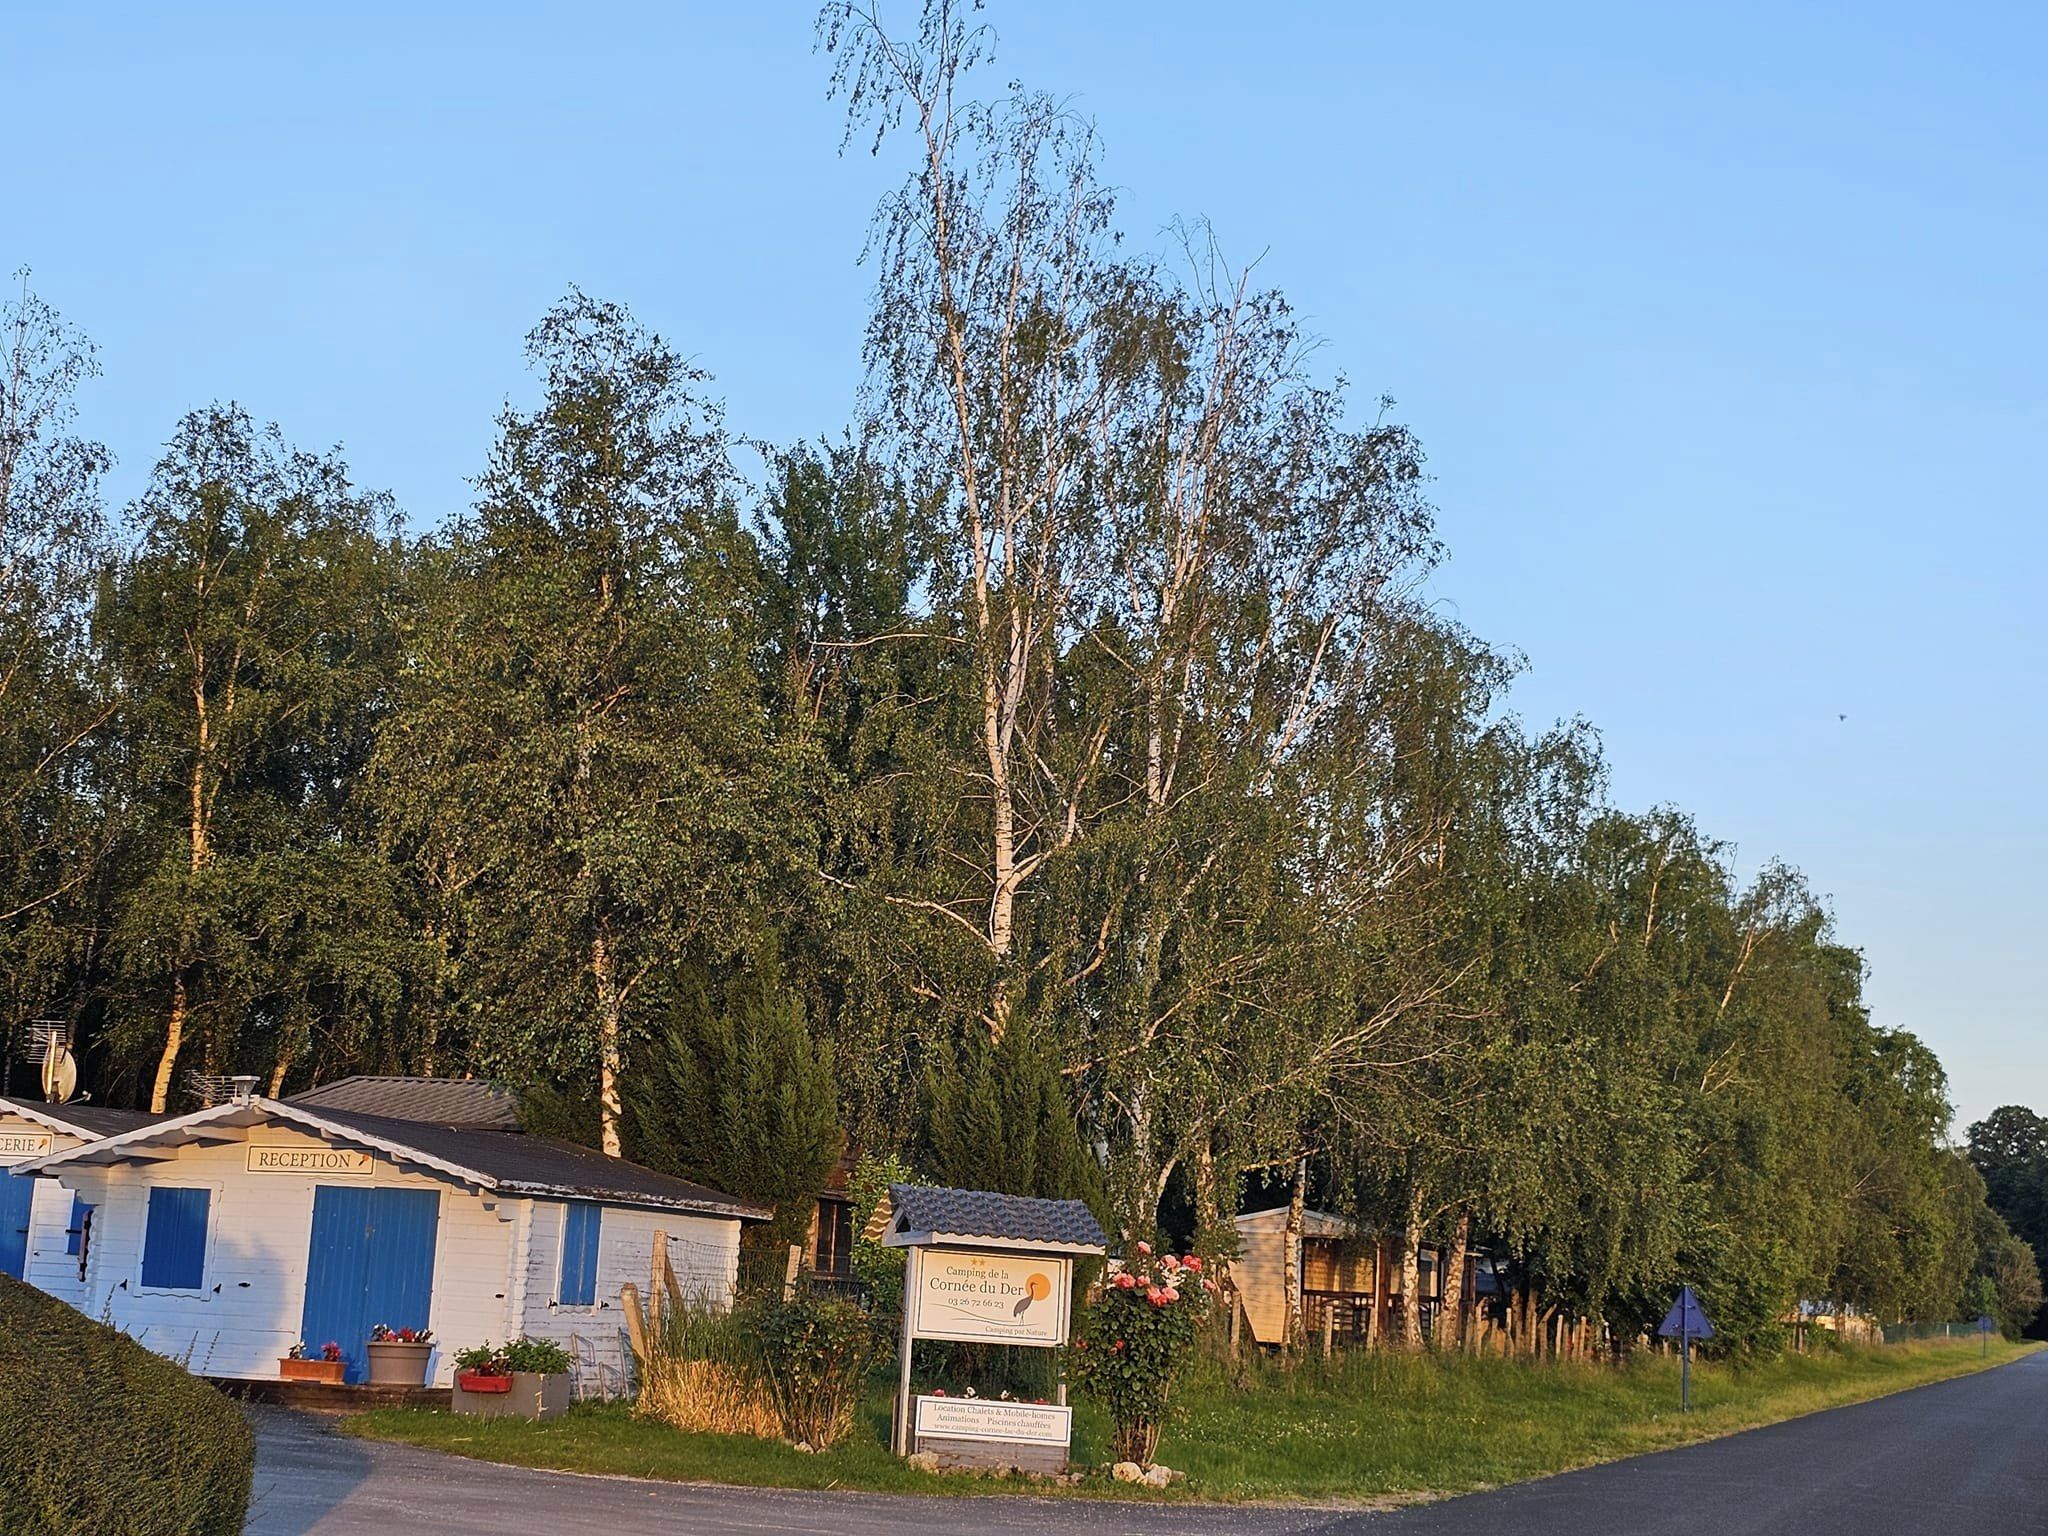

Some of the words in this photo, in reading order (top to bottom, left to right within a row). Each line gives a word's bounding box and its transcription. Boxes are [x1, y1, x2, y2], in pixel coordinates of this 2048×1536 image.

[259, 1152, 351, 1168] RECEPTION
[946, 1266, 986, 1279] Camping
[988, 1269, 999, 1278] de
[1001, 1270, 1009, 1279] la
[930, 1277, 976, 1292] Cornée
[979, 1281, 996, 1294] du
[1001, 1283, 1024, 1296] Der
[948, 1297, 958, 1306] 03
[960, 1297, 970, 1305] 26
[971, 1299, 981, 1307] 72
[983, 1299, 993, 1307] 66
[994, 1301, 1004, 1309] 23
[985, 1325, 1013, 1336] Camping
[1026, 1328, 1048, 1337] Nature
[934, 1403, 965, 1413] Location
[967, 1406, 994, 1415] Chalets
[1004, 1409, 1055, 1420] Mobile-homes
[937, 1414, 980, 1424] Animations
[987, 1416, 1016, 1426] Piscines
